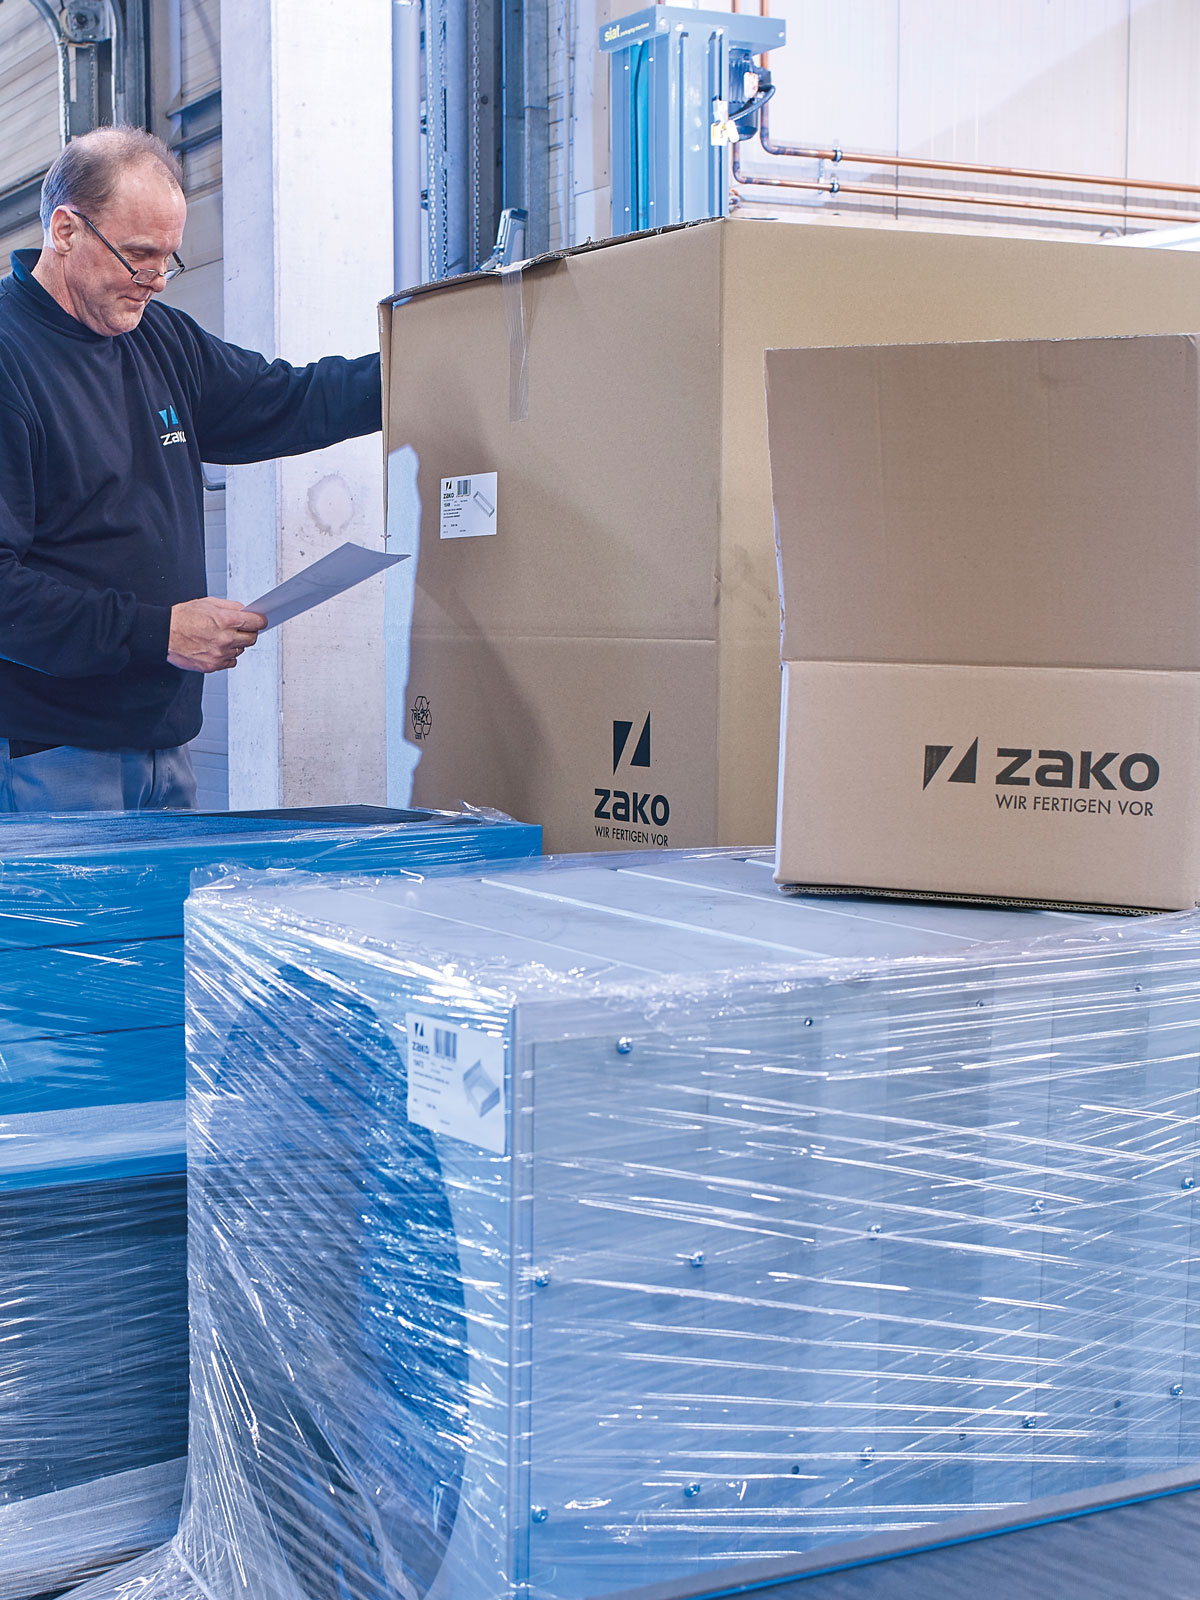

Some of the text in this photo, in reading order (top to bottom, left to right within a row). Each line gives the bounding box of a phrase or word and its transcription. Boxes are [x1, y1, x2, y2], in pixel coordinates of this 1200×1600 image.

[995, 747, 1160, 792] zako
[594, 788, 670, 827] zako
[995, 794, 1154, 817] WIR FERTIGEN VOR
[594, 825, 669, 847] WIR FERTIGEN VOR
